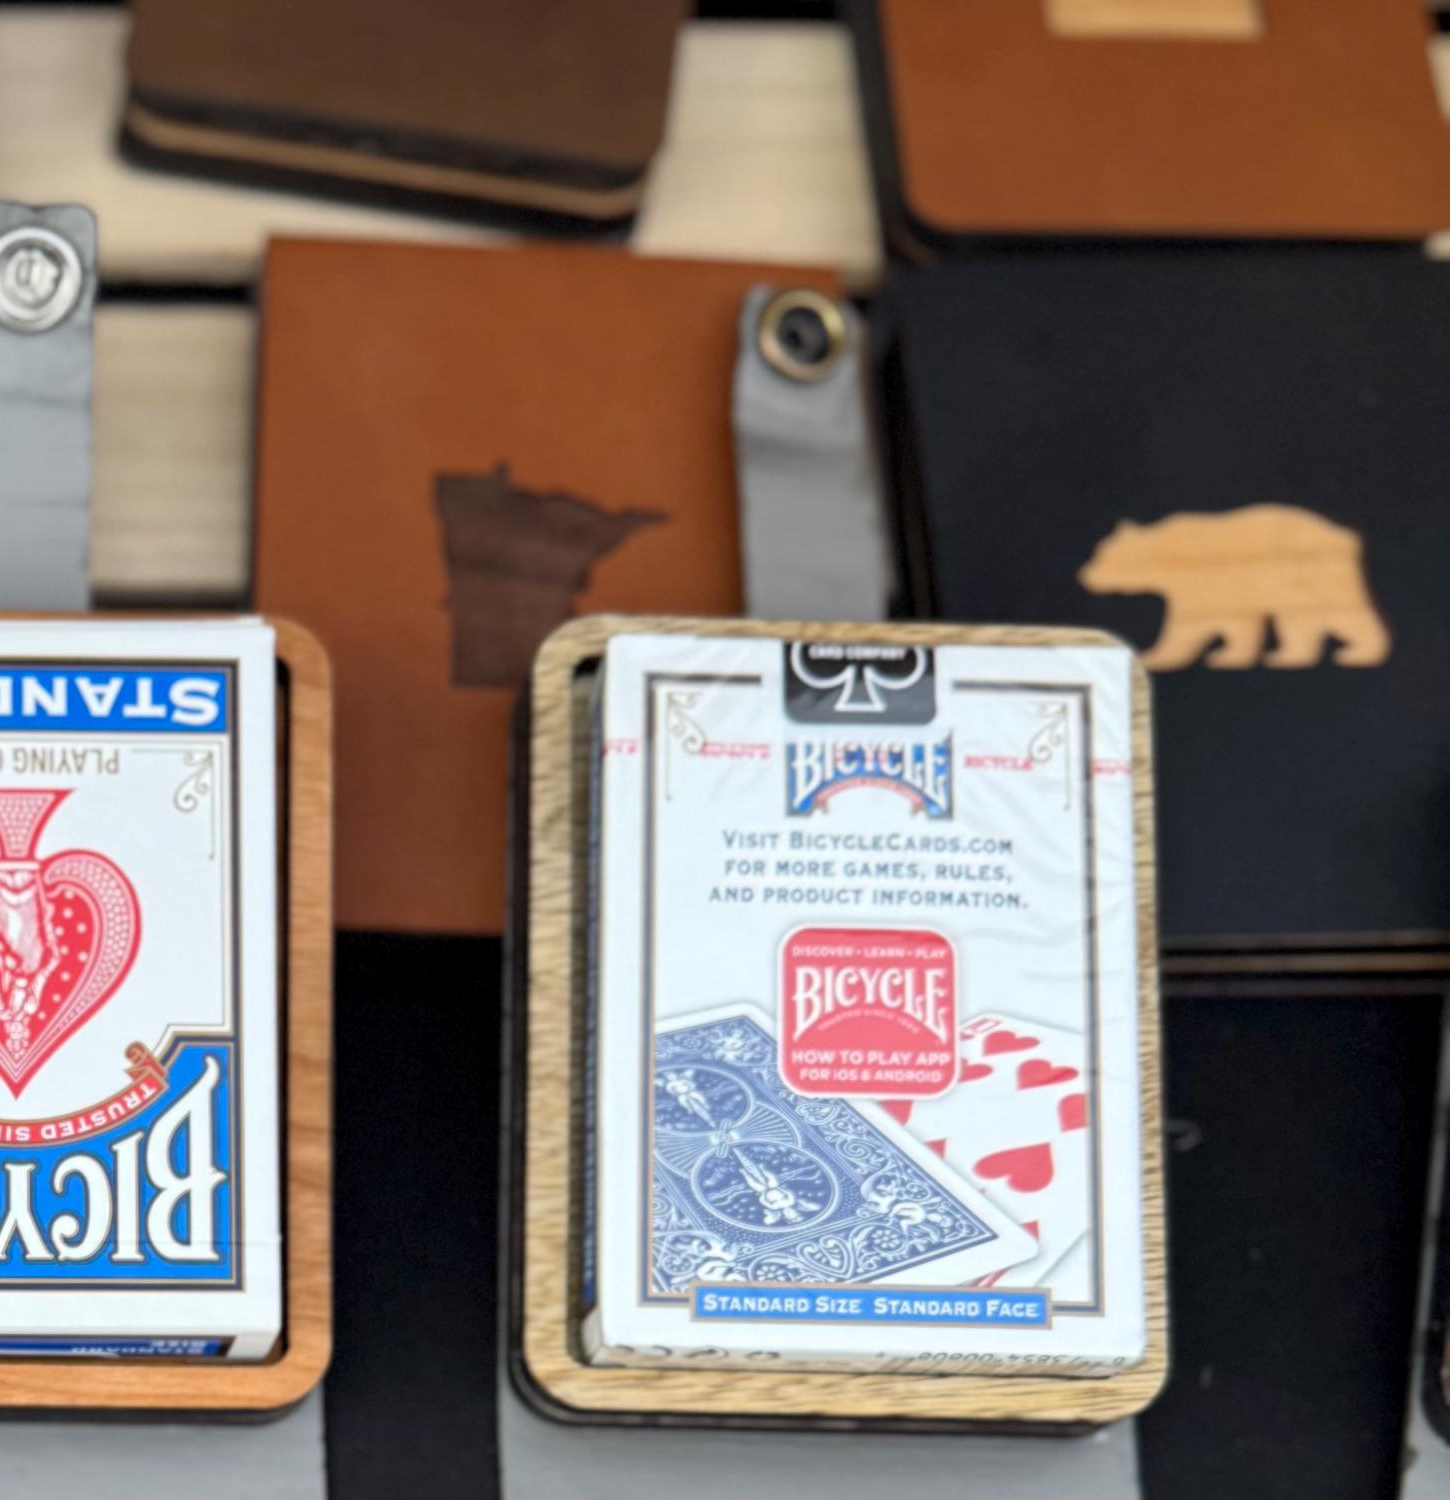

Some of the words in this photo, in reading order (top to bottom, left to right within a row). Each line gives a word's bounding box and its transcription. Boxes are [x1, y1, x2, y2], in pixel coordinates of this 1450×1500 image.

[16, 747, 120, 775] PLAYING
[792, 741, 948, 812] BICYCLE
[724, 859, 766, 876] FOR
[775, 860, 835, 877] MORE
[843, 861, 926, 881] GAMES,
[935, 864, 1012, 884] RULES,
[709, 887, 754, 904] AND
[763, 888, 862, 906] PRODUCT
[872, 889, 1030, 910] INFORMATION.
[792, 965, 947, 1045] BICYCLE
[791, 1050, 834, 1064] HOW
[839, 1051, 863, 1064] TO
[867, 1052, 912, 1065] PLAY
[916, 1052, 951, 1066] APP
[800, 1068, 831, 1080] FOR
[874, 1069, 942, 1083] ANDROID
[42, 1079, 156, 1140] TRUSTED
